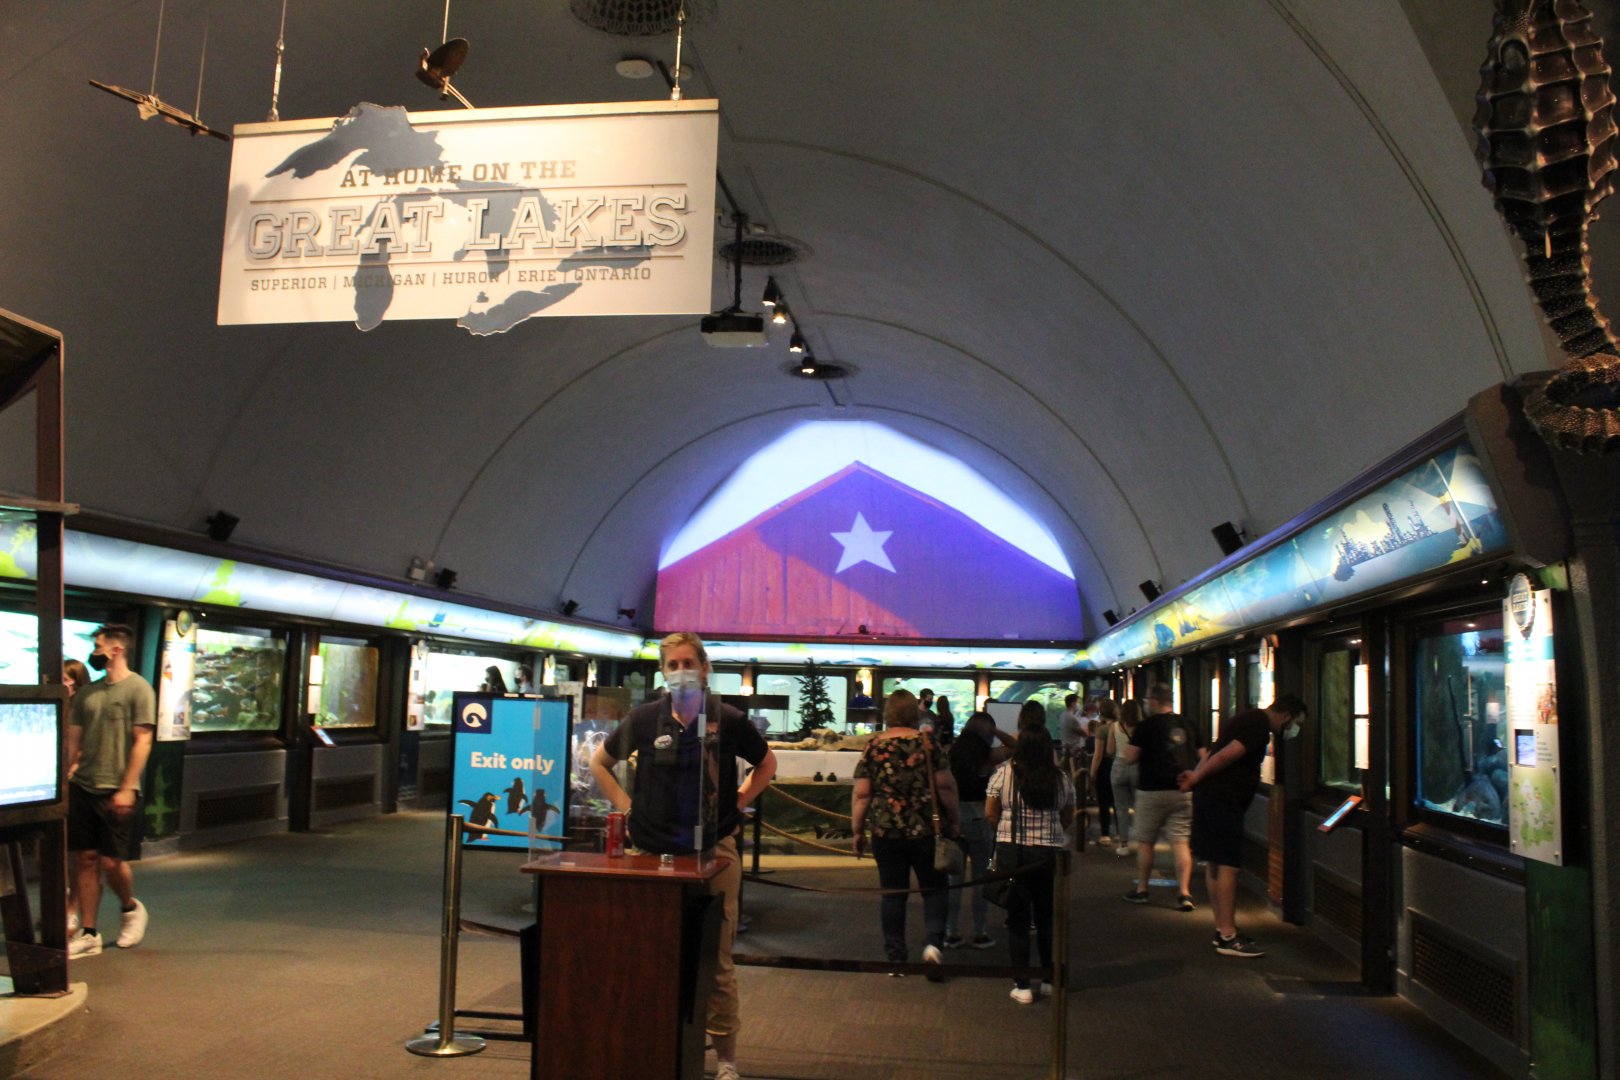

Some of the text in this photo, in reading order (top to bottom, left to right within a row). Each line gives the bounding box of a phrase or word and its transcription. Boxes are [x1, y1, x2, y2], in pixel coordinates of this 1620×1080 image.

[340, 159, 577, 188] AT HOME ON THE
[249, 193, 687, 260] GREAT LAKES
[250, 267, 652, 291] SUPERIOR MICHIGAN HURON ERIE ONTARIO
[470, 751, 555, 775] Exit only
